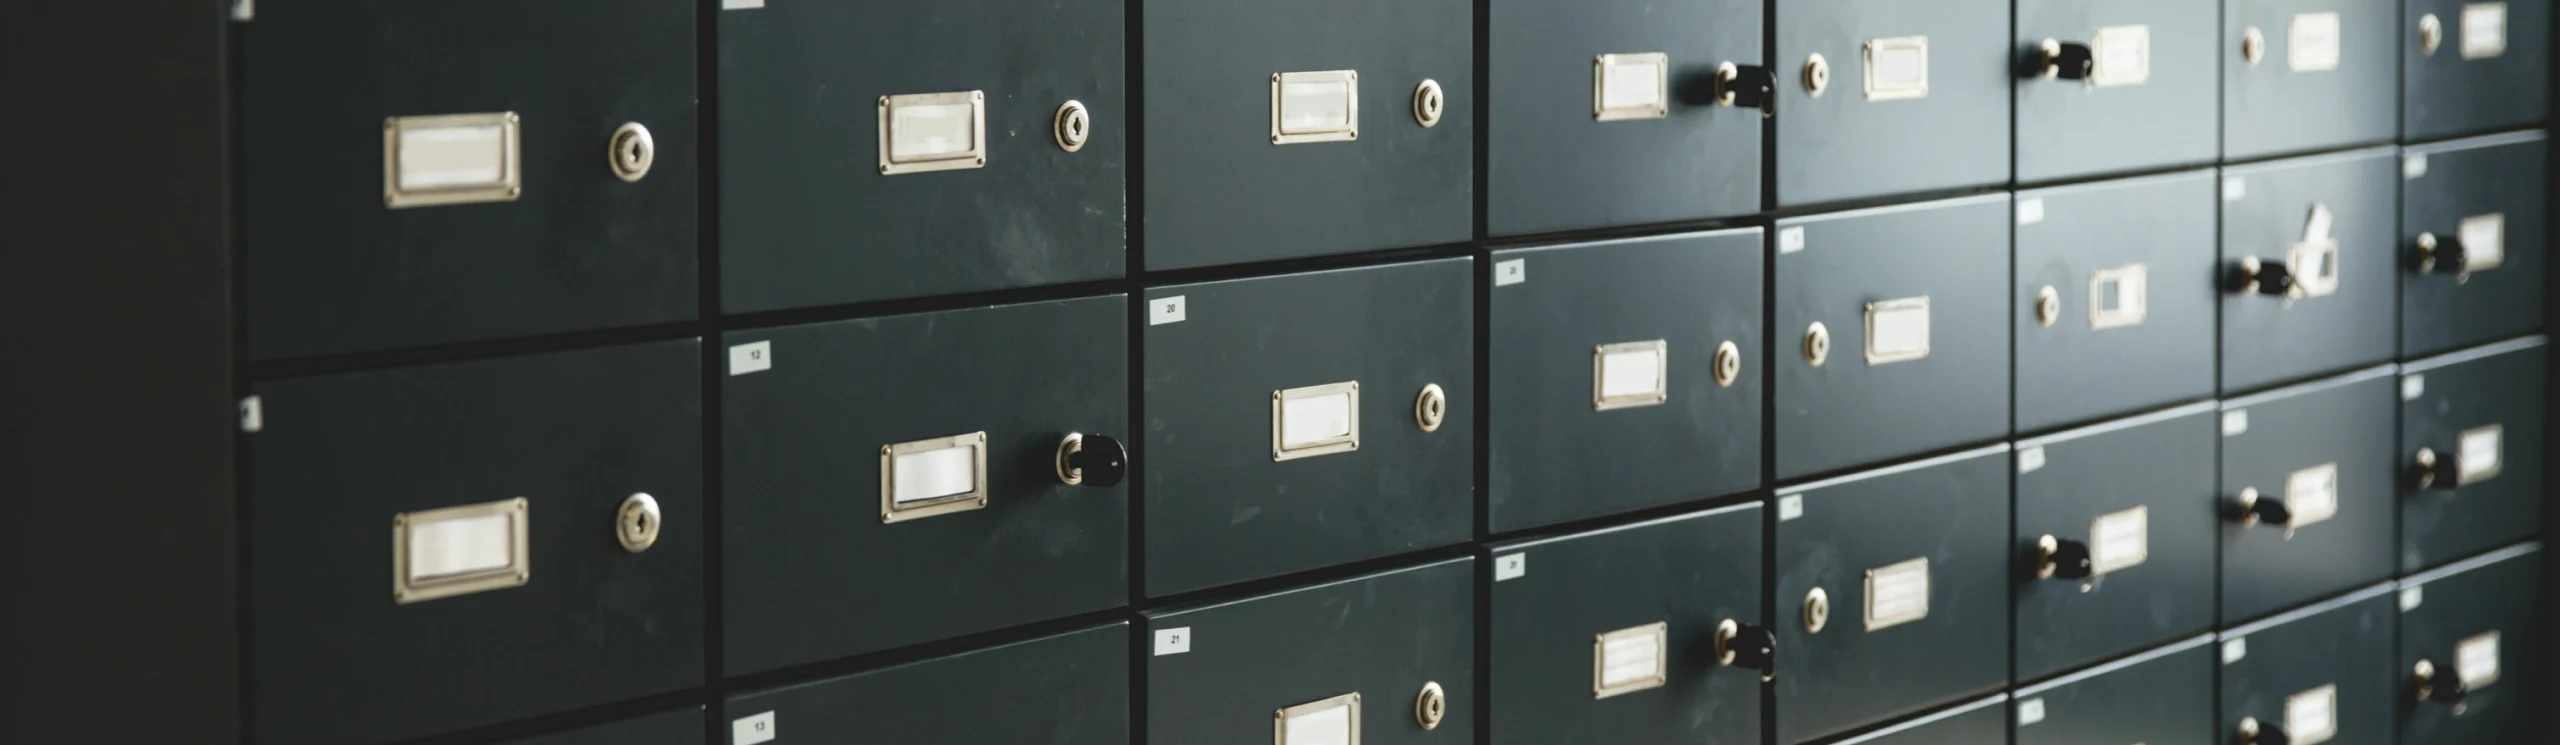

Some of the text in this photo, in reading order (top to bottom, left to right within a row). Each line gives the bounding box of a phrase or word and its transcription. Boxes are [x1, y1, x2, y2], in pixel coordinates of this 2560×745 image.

[1166, 303, 1175, 313] 20
[750, 349, 760, 360] 12
[1170, 634, 1179, 644] 21
[754, 720, 765, 732] 13
